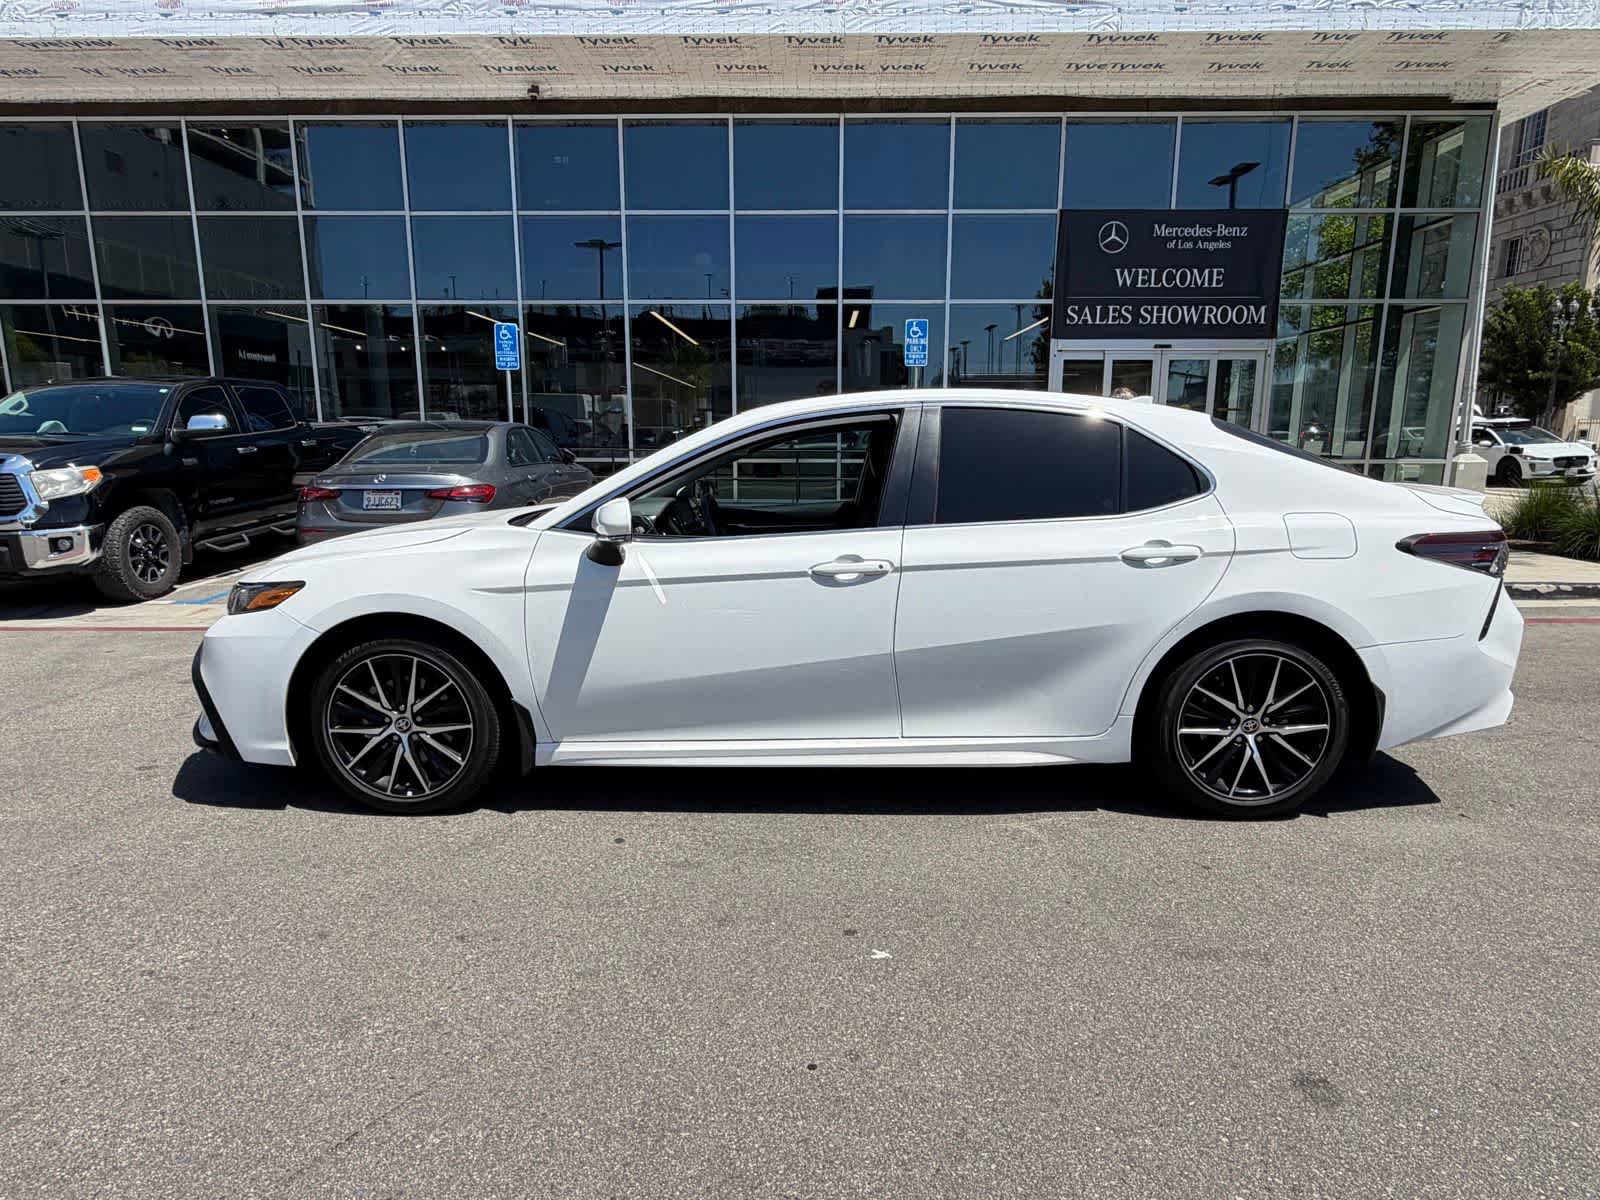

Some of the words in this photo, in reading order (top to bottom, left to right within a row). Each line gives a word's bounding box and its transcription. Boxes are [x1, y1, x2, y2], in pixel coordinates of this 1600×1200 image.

[389, 36, 454, 46] Tyvek
[493, 36, 533, 46] Tyk
[575, 36, 637, 46] Tyvek
[680, 36, 741, 45] Tyvek
[784, 35, 843, 45] Tyvek
[874, 34, 936, 45] Tyvek
[980, 34, 1041, 44] Tyvek
[1206, 32, 1268, 43] Tyvek
[1386, 31, 1449, 42] Tyvek
[153, 38, 218, 48] Tyvek
[286, 37, 350, 47] Tyvek
[287, 65, 347, 74] Tyvek
[382, 64, 443, 74] Tyvek
[600, 64, 656, 72] Tyvek
[968, 62, 1024, 71] Tyvek
[1207, 61, 1265, 71] Tyvek
[1394, 60, 1453, 69] Tyvek
[1152, 223, 1248, 238] Mercedes-Benz
[1166, 240, 1175, 250] of
[1178, 239, 1194, 249] Los
[1196, 239, 1232, 251] Angeles
[1115, 268, 1225, 288] WELCOME
[1066, 305, 1132, 325] SALES
[1139, 304, 1268, 325] SHOWROOM
